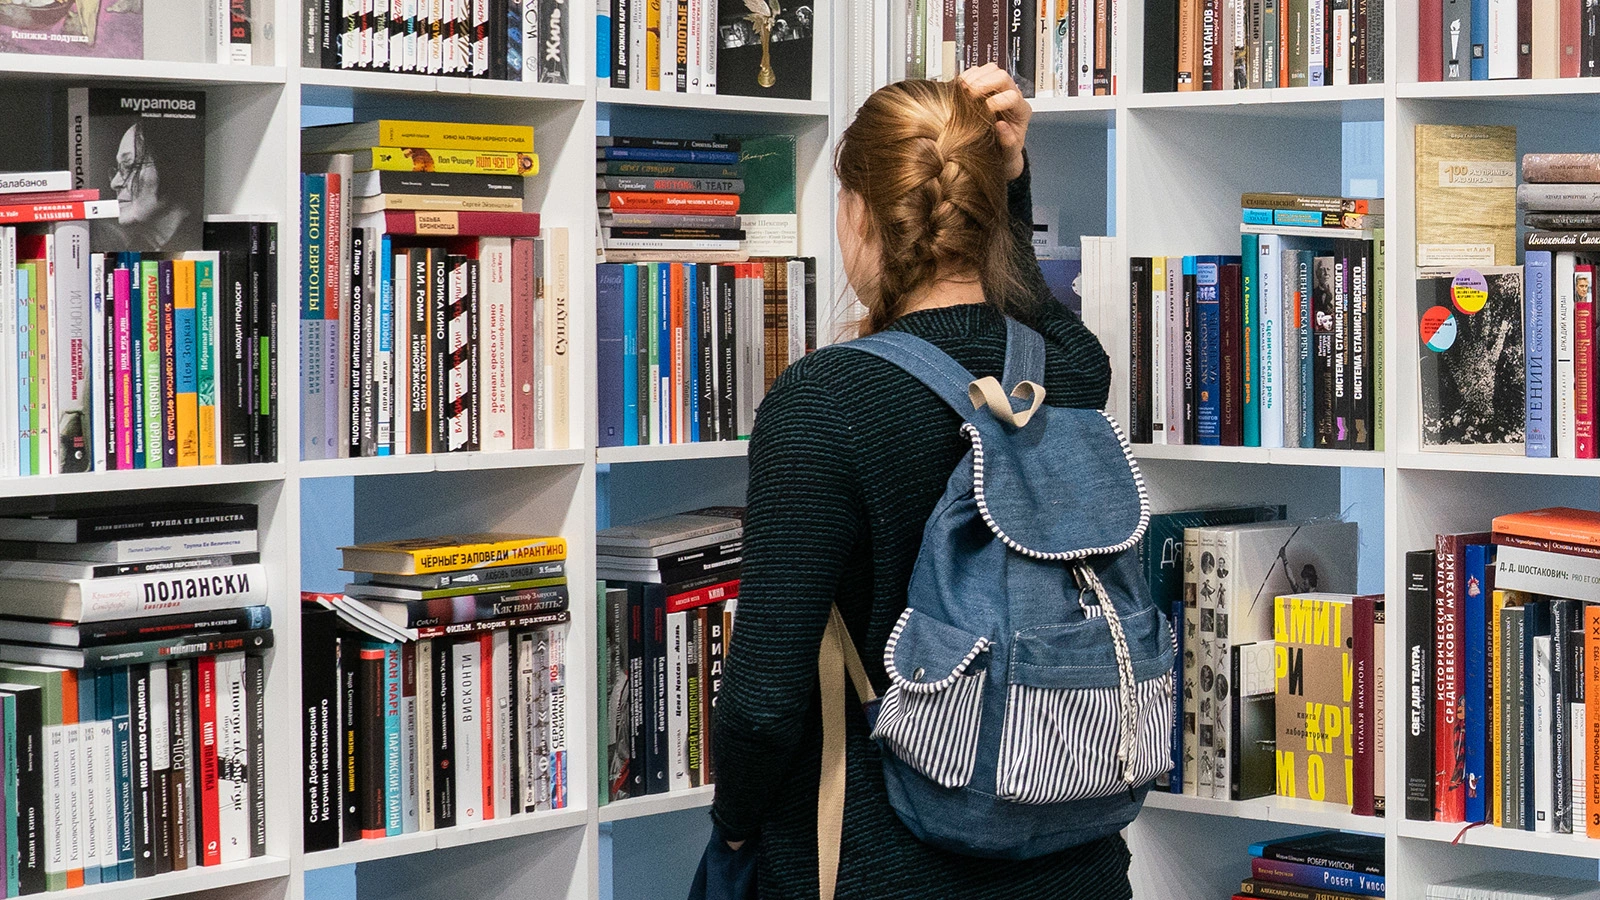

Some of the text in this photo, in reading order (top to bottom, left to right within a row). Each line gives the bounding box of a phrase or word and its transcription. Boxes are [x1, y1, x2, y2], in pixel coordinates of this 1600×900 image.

[322, 22, 330, 49] Лакан
[546, 8, 561, 62] Жиль
[618, 23, 626, 66] ДОРОЖНАЯ
[677, 4, 687, 64] ЗОЛОТЫЕ
[1203, 9, 1213, 67] ВАХТАНГОВ
[705, 180, 733, 192] ТЕАТР
[308, 193, 320, 312] КИНО ЕВРОПЫ
[327, 192, 335, 288] АМЕРИКАНСКОГО КИНО
[147, 275, 158, 352] АЛЕКСАНДРОВ
[234, 282, 242, 323] ПРОДЮСЕР
[416, 261, 425, 322] М.И. Ромм
[436, 261, 445, 340] ПОЭТИКА КИНО
[1299, 262, 1308, 360] СЦЕНИЧЕСКАЯ РЕЧЬ
[182, 318, 192, 359] Зоркая
[351, 238, 361, 446] С. Ландо ФОТОКОМПОЗИЦИЯ ДЛЯ КИНОШКОЛЫ
[490, 328, 497, 341] от
[499, 303, 507, 351] кинофорума
[555, 297, 568, 356] Сундук
[1184, 331, 1192, 357] РОБЕРТ
[1265, 319, 1273, 381] Сценическая
[1334, 263, 1343, 398] СИСТЕМА СТАНИСЛАВСКОГО
[1353, 265, 1362, 400] СИСТЕМА СТАНИСЛАВСКОГО
[363, 360, 373, 404] МОСКВИН,
[412, 340, 420, 412] КИНОРЕЖИССУРЕ
[471, 344, 479, 393] КИНОФОРМЫ
[490, 342, 498, 370] ересь
[499, 352, 507, 388] рижского
[703, 346, 711, 401] Антология
[724, 347, 732, 402] Антология
[1184, 357, 1192, 390] УИЛСОН
[490, 371, 498, 414] арсенал:
[499, 404, 506, 413] 25
[1530, 355, 1543, 423] ГЕНИЙ
[150, 375, 161, 462] ЛЮБОВЬ ОРЛОВА
[364, 405, 373, 439] АНДРЕЙ
[471, 393, 479, 444] ДРАМАТУРГИЯ
[150, 518, 182, 528] ТРУППА
[193, 514, 245, 526] ВЕЛИЧЕСТВА
[460, 549, 509, 564] ЗАПОВЕДИ
[511, 543, 564, 559] ТАРАНТИНО
[445, 622, 475, 635] ФИЛЬМ.
[492, 602, 513, 615] Как
[513, 603, 531, 614] нам
[1436, 552, 1446, 701] ИСТОРИЧЕСКИЙ АТЛАС
[658, 656, 666, 672] Как
[1444, 552, 1455, 724] СРЕДНЕВЕКОВОЙ МУЗЫКИ
[462, 653, 473, 722] ВИСКОНТИ
[549, 664, 559, 750] СЕРИЙНЫЕ 105
[675, 693, 683, 717] Цена
[1357, 659, 1365, 754] НАТАЛЬЯ МАКАРОВА
[1411, 644, 1421, 737] СВЕТ ДЛЯ ТЕАТРА
[118, 721, 128, 732] 97
[137, 678, 149, 788] КИНО БАКО САДЫКОВА
[388, 649, 400, 829] ЖАН МАРЕ ПАРИЖСКИЕ ТАЙНЫ
[558, 685, 566, 749] ЛЮБИМЦЫ
[687, 676, 699, 770] АНДРЕЙ ТАРКОВСКИЙ
[120, 740, 129, 778] записки
[173, 737, 185, 771] РОЛЬ
[254, 742, 264, 799] МЕЛЬНИКОВ
[308, 706, 320, 823] Сергей Добротворский
[320, 699, 330, 821] Источник невозможного
[347, 730, 355, 792] ЖИЗНЬ ПАЗОЛИНИ
[27, 806, 36, 869] Лакан кино
[255, 800, 265, 845] ВИТАЛИЙ
[1306, 856, 1355, 871] РОБЕРТ УИЛСОН
